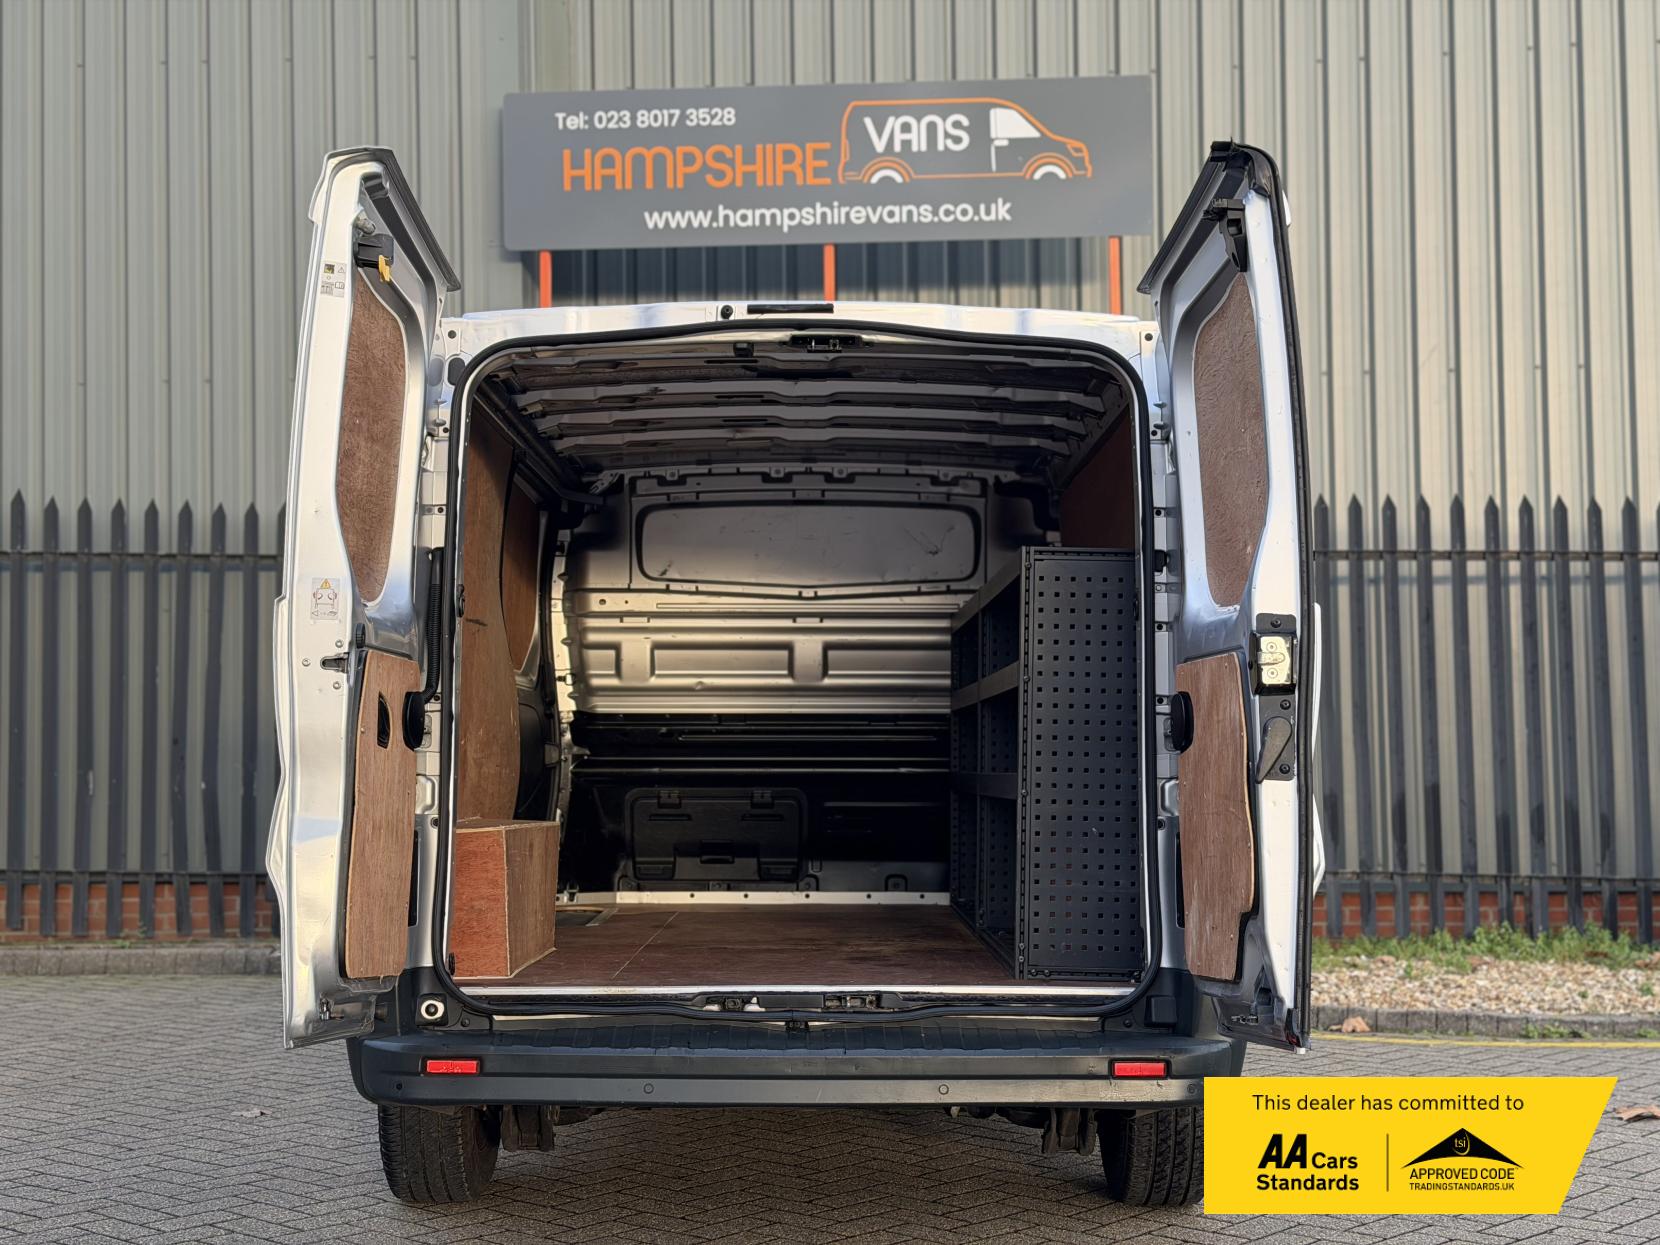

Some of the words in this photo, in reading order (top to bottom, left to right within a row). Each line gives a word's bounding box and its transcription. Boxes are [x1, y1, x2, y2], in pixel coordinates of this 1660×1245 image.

[555, 111, 588, 131] Tel:
[594, 109, 631, 129] 023
[636, 108, 680, 128] 8017
[686, 106, 736, 126] 3528
[563, 142, 832, 192] HAMPSHIRE
[863, 114, 970, 154] VANS
[644, 196, 1012, 233] www.hampshirevans.co.uk
